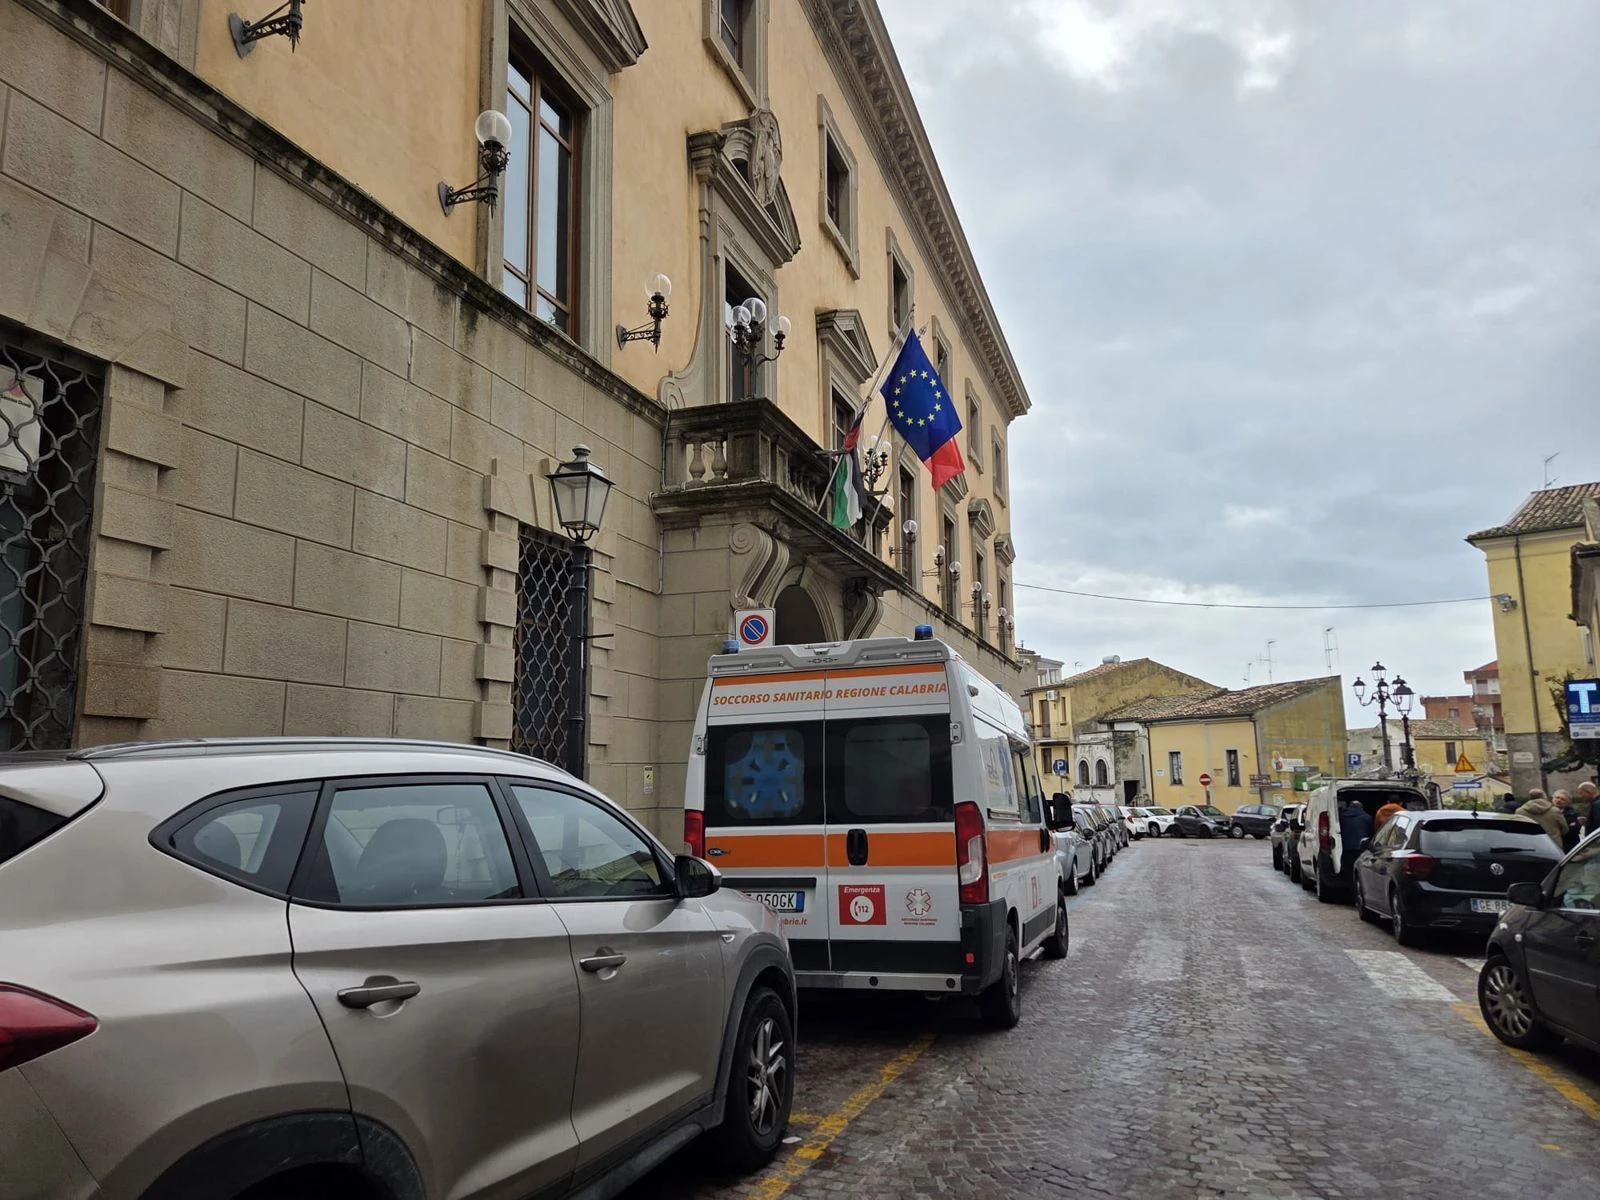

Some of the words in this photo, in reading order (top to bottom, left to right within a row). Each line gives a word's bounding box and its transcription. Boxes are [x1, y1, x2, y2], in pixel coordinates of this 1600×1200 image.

[713, 694, 770, 706] SOCCORSO
[773, 690, 833, 703] SANITARIO
[836, 686, 887, 699] REGIONE
[889, 682, 947, 695] CALABRIA
[1568, 683, 1597, 714] T
[1350, 754, 1359, 764] P
[1056, 760, 1064, 770] P
[844, 886, 881, 895] Emergenza
[857, 905, 869, 913] 112
